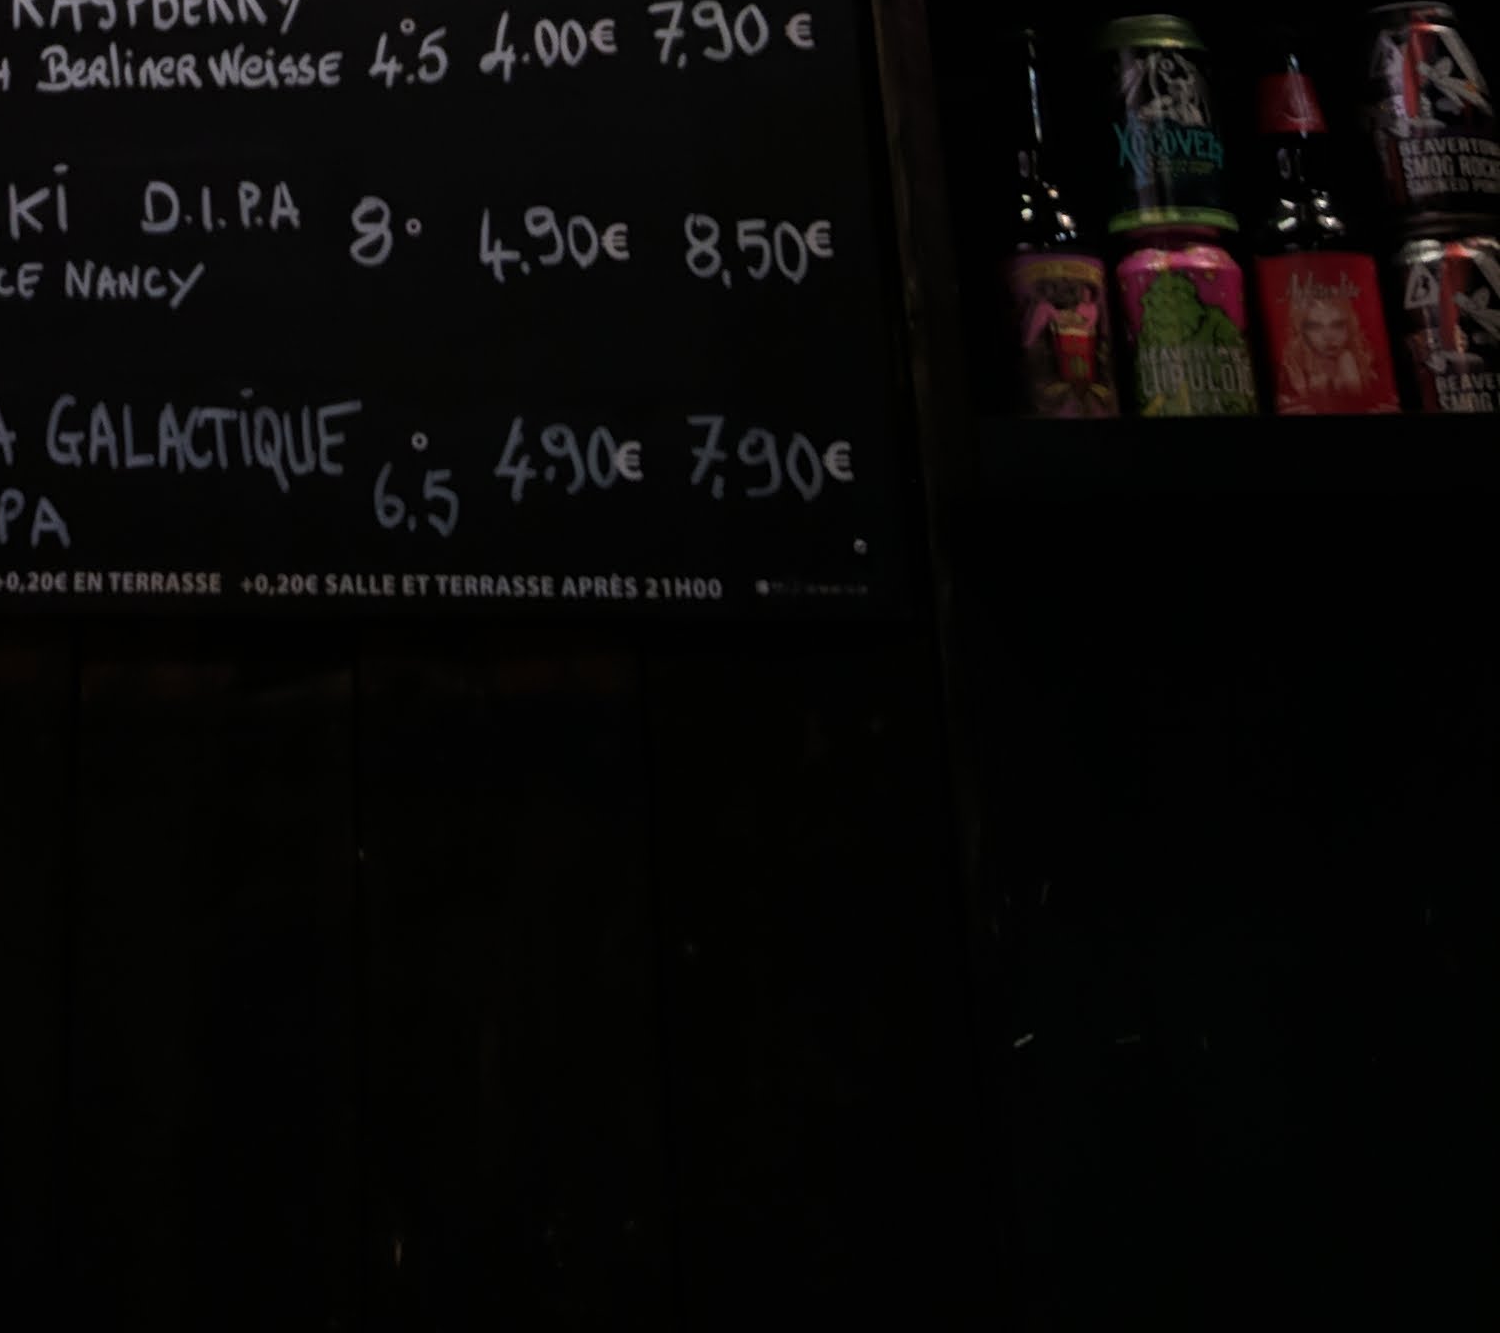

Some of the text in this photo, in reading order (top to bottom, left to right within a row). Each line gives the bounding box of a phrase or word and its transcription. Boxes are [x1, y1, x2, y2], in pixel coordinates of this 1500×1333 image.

[64, 259, 206, 310] NANCY
[73, 570, 103, 594] EN
[107, 570, 221, 595] TERRASSE
[239, 572, 318, 597] +0,20€
[323, 573, 396, 598] SALLE
[401, 573, 431, 598] ET
[434, 573, 555, 599] TERRASSE
[560, 572, 640, 600] APRÈS
[644, 576, 724, 600] 21H00
